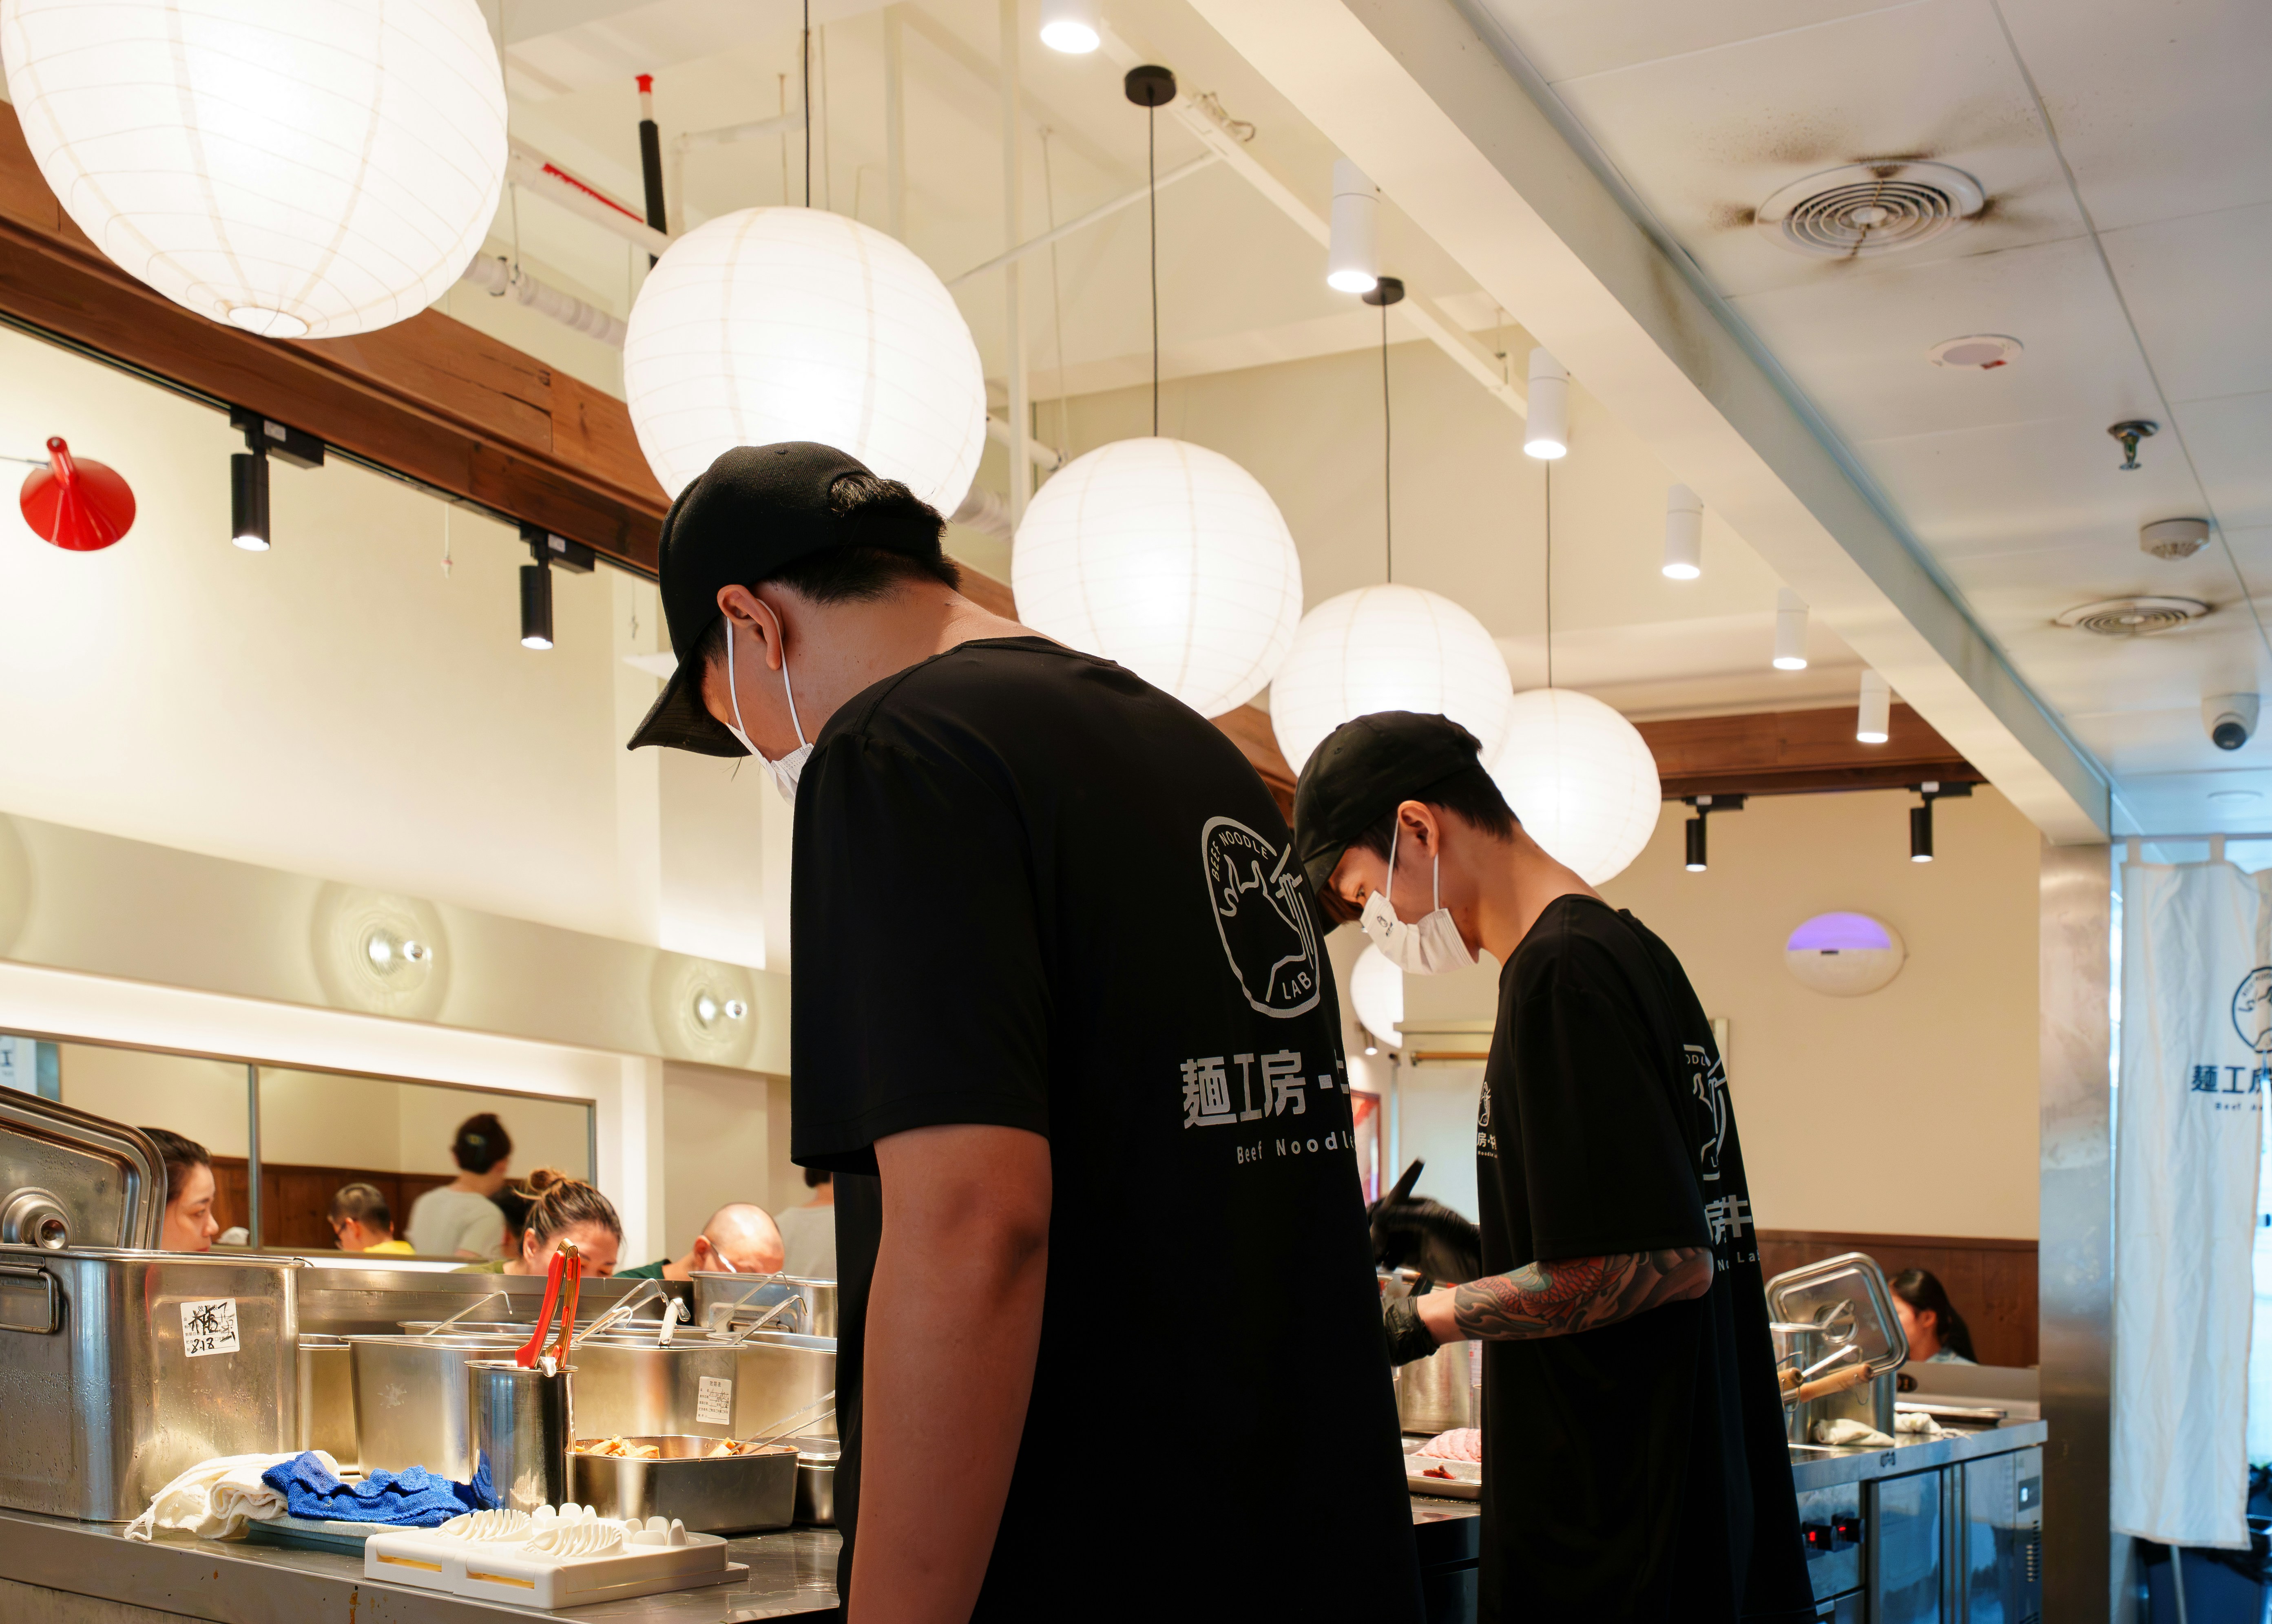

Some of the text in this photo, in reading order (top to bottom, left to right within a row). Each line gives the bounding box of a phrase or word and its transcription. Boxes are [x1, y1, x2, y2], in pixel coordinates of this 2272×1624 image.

[1211, 831, 1268, 882] BEEF NOODLE
[1282, 971, 1312, 1000] LAB
[1237, 1141, 1262, 1164] Beef
